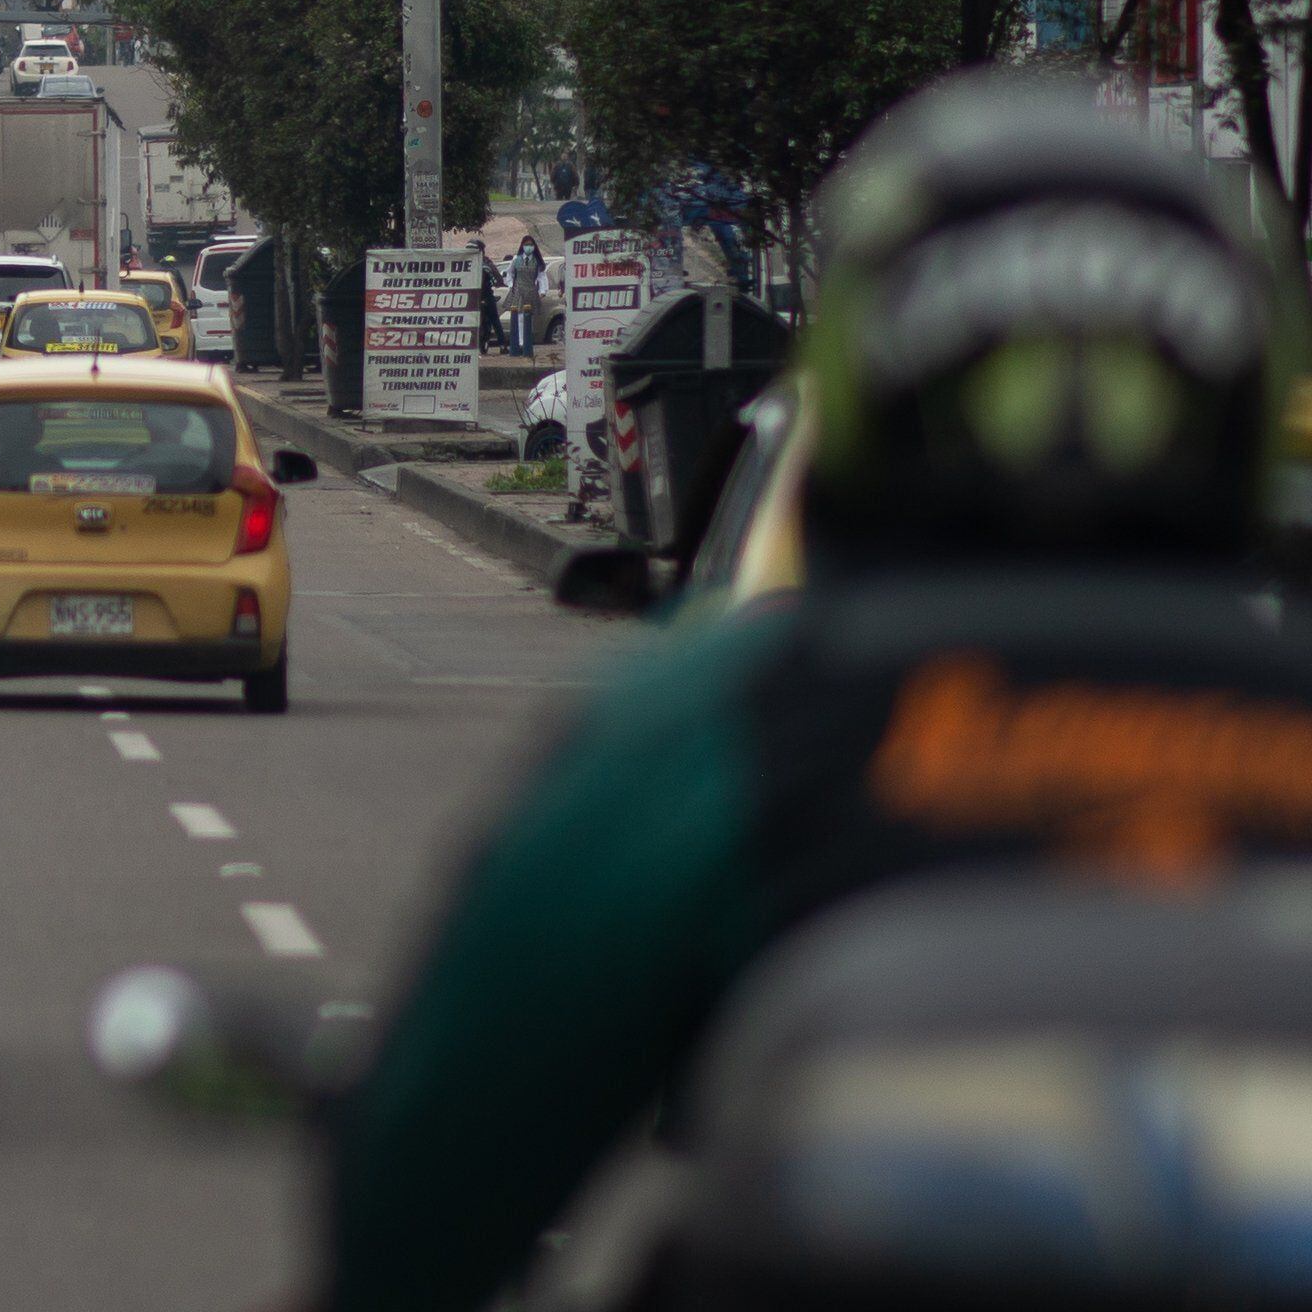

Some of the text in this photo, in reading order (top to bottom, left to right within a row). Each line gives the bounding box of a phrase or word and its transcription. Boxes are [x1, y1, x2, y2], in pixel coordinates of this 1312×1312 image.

[372, 260, 473, 273] LAVADO DE
[382, 277, 463, 288] AUTOMOVIL
[374, 292, 469, 309] $15.000
[381, 315, 464, 326] CAMIONETA
[368, 330, 473, 346] $20.000
[432, 354, 451, 364] DEL
[379, 368, 461, 378] PARA LA PLACA
[444, 381, 458, 390] EN
